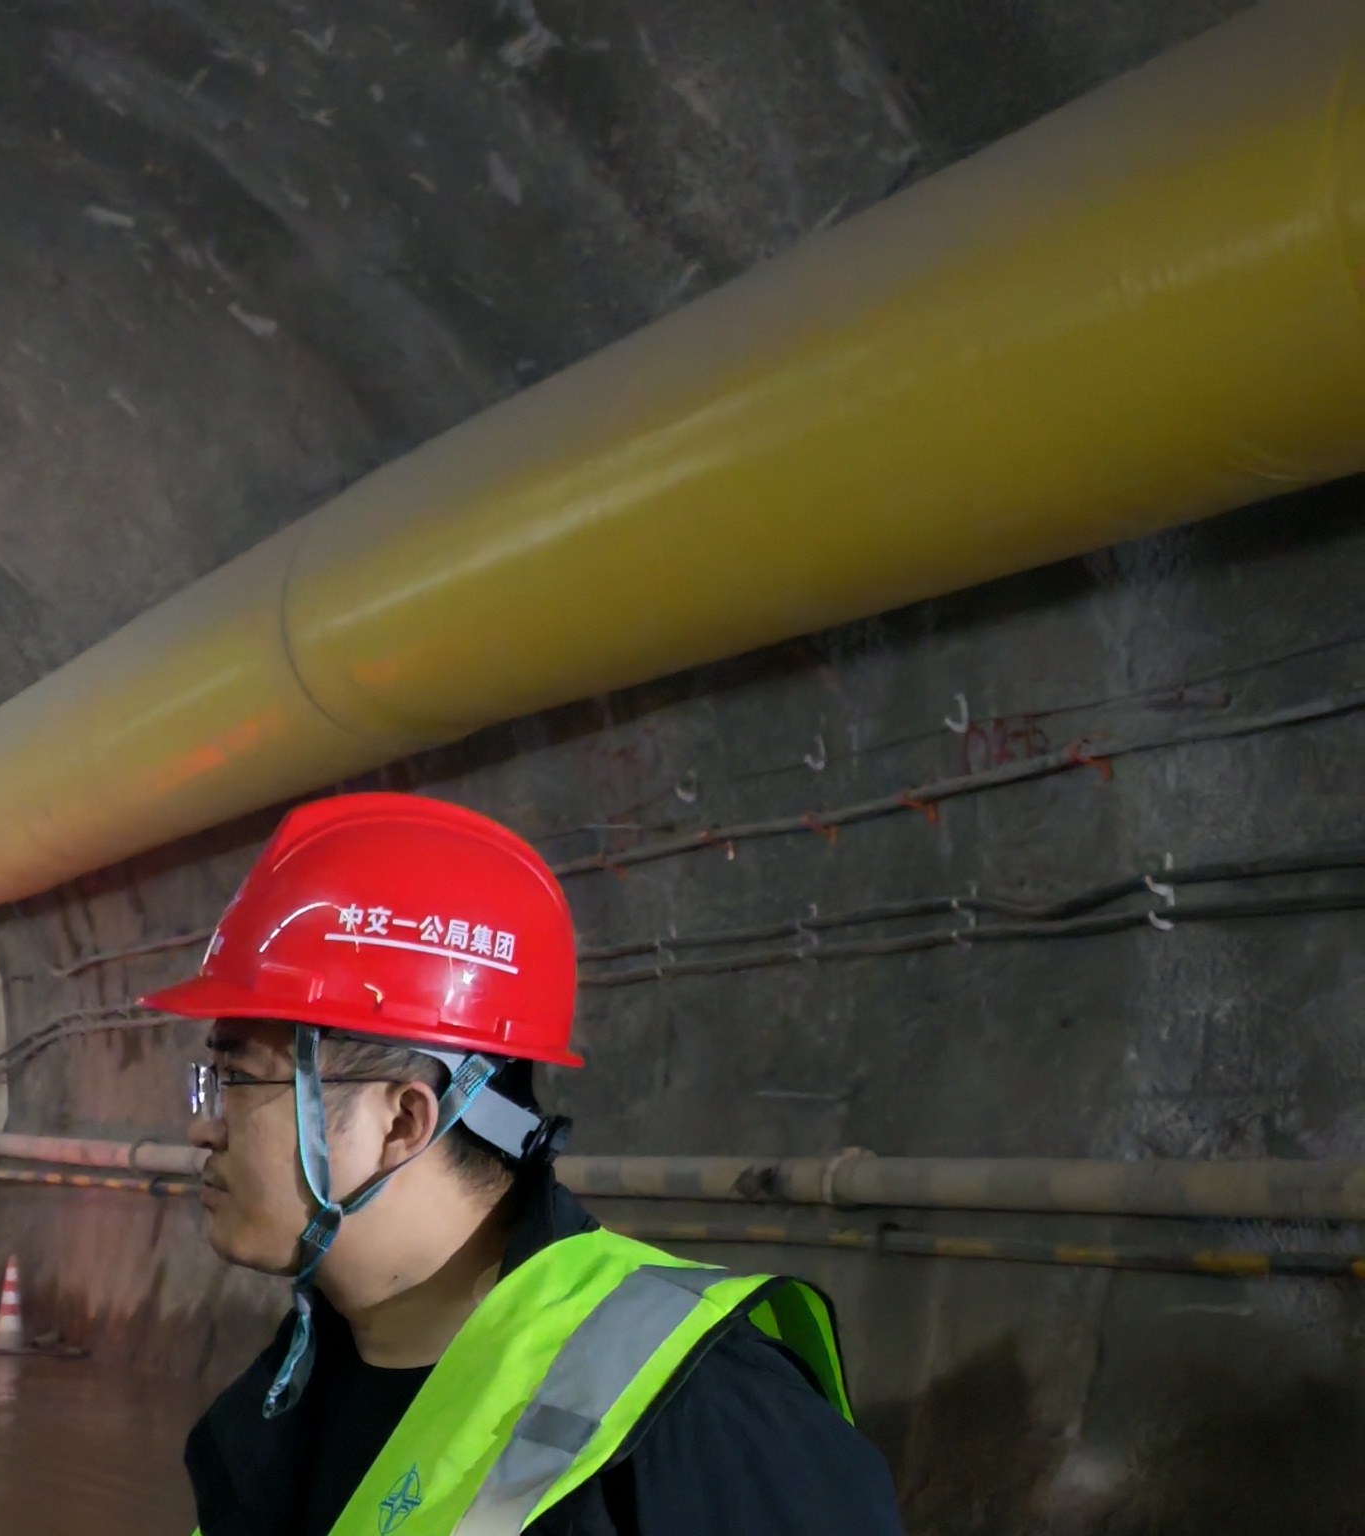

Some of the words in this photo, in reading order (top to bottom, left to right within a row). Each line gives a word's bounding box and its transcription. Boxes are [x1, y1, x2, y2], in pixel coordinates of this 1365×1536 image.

[338, 904, 516, 962] 中交一公局集团
